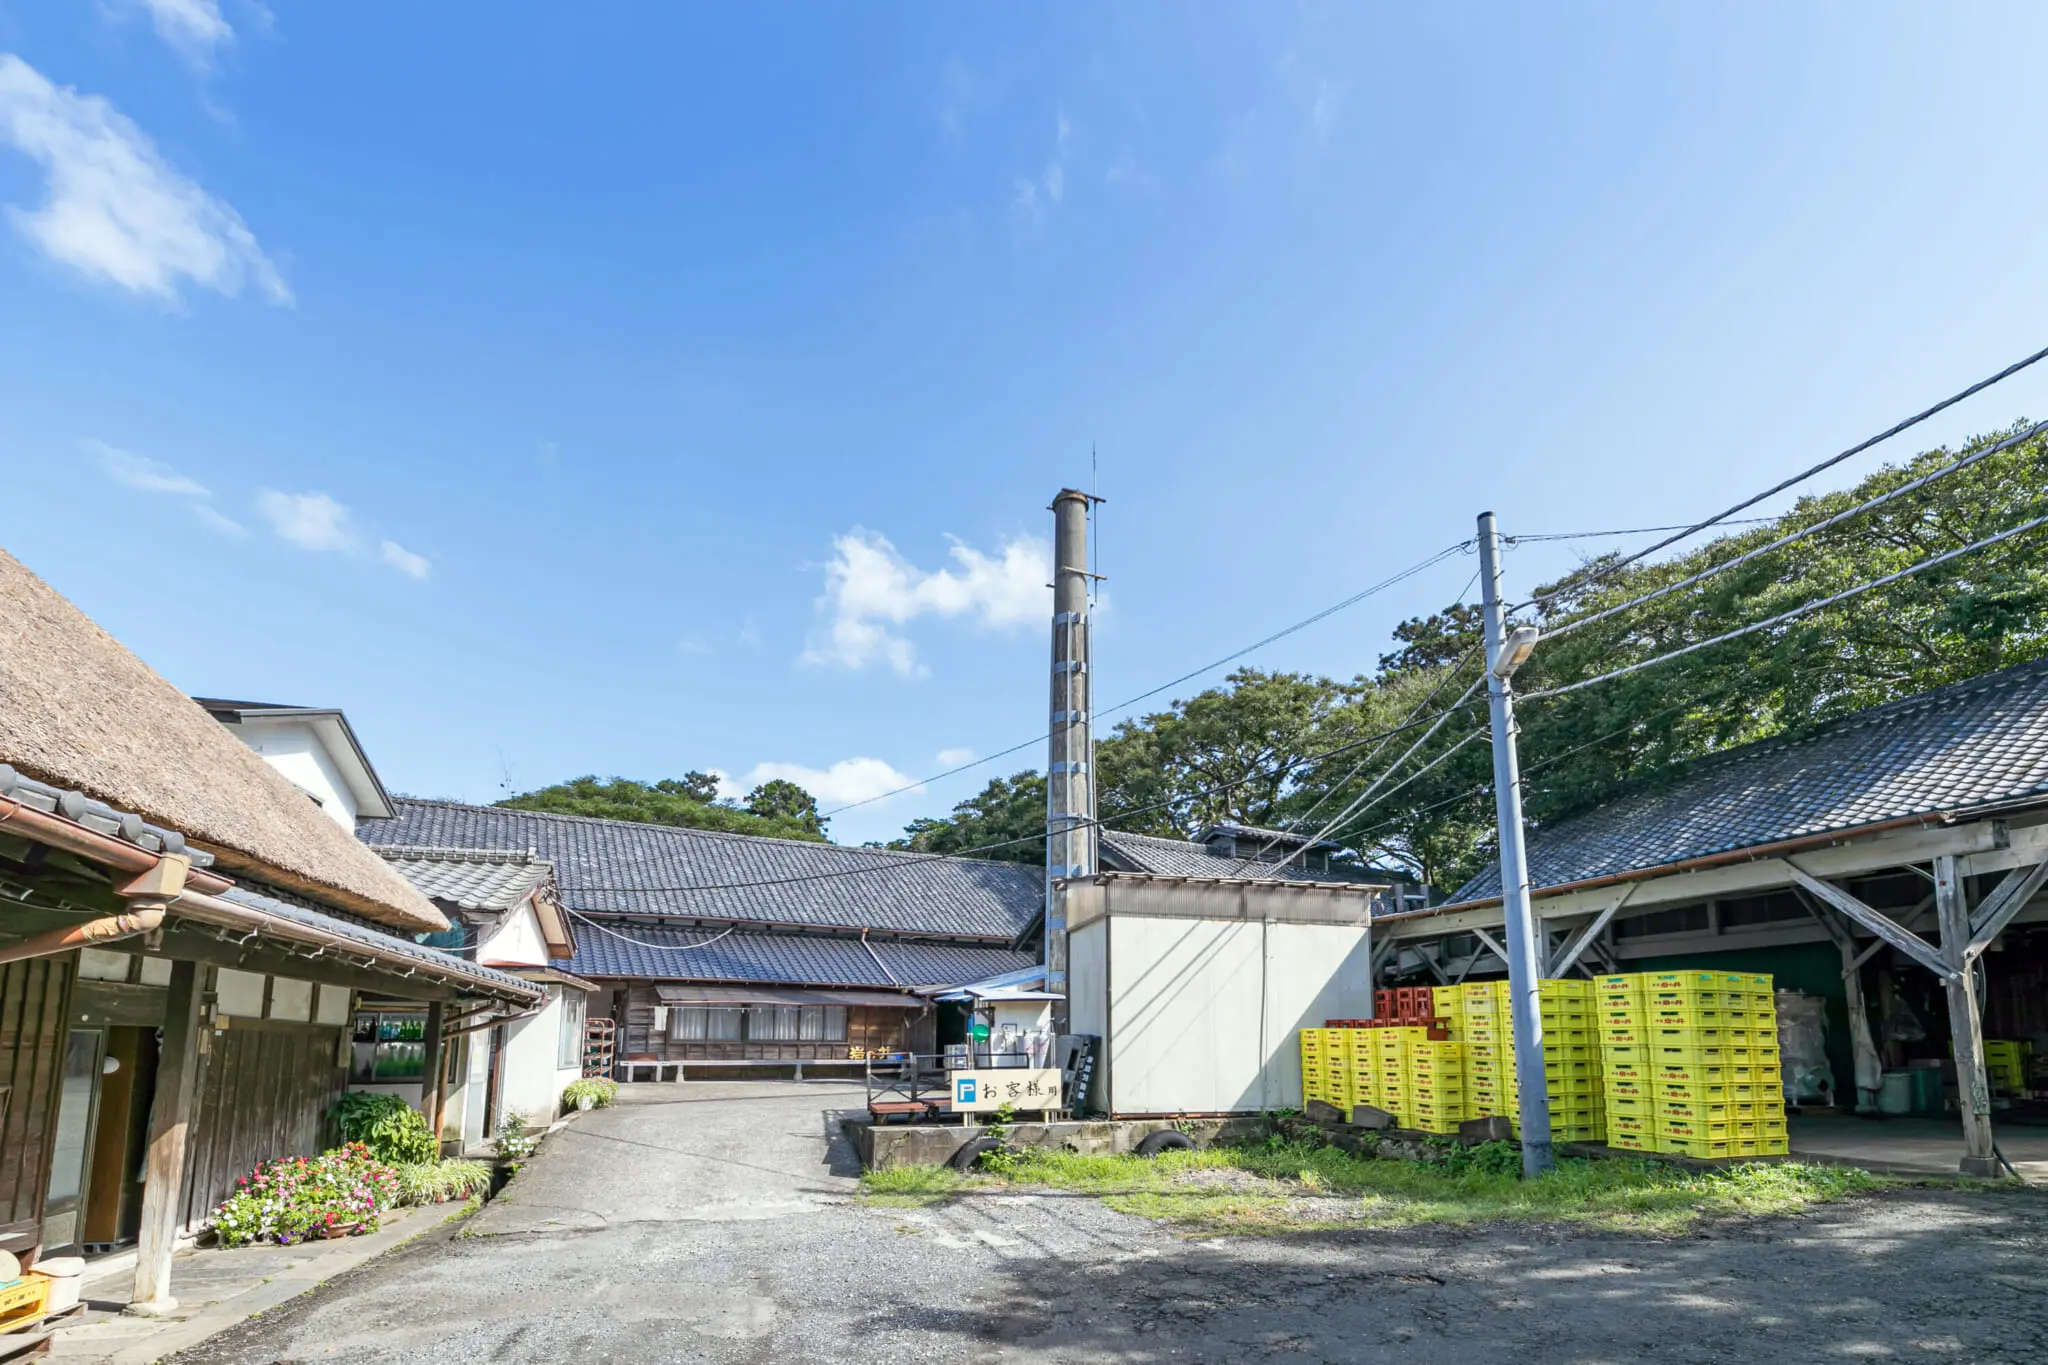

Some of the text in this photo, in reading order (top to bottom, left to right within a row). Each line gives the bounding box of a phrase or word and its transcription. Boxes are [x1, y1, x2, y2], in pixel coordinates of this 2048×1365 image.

[959, 1084, 974, 1100] P
[983, 1079, 1057, 1099] お客様用
